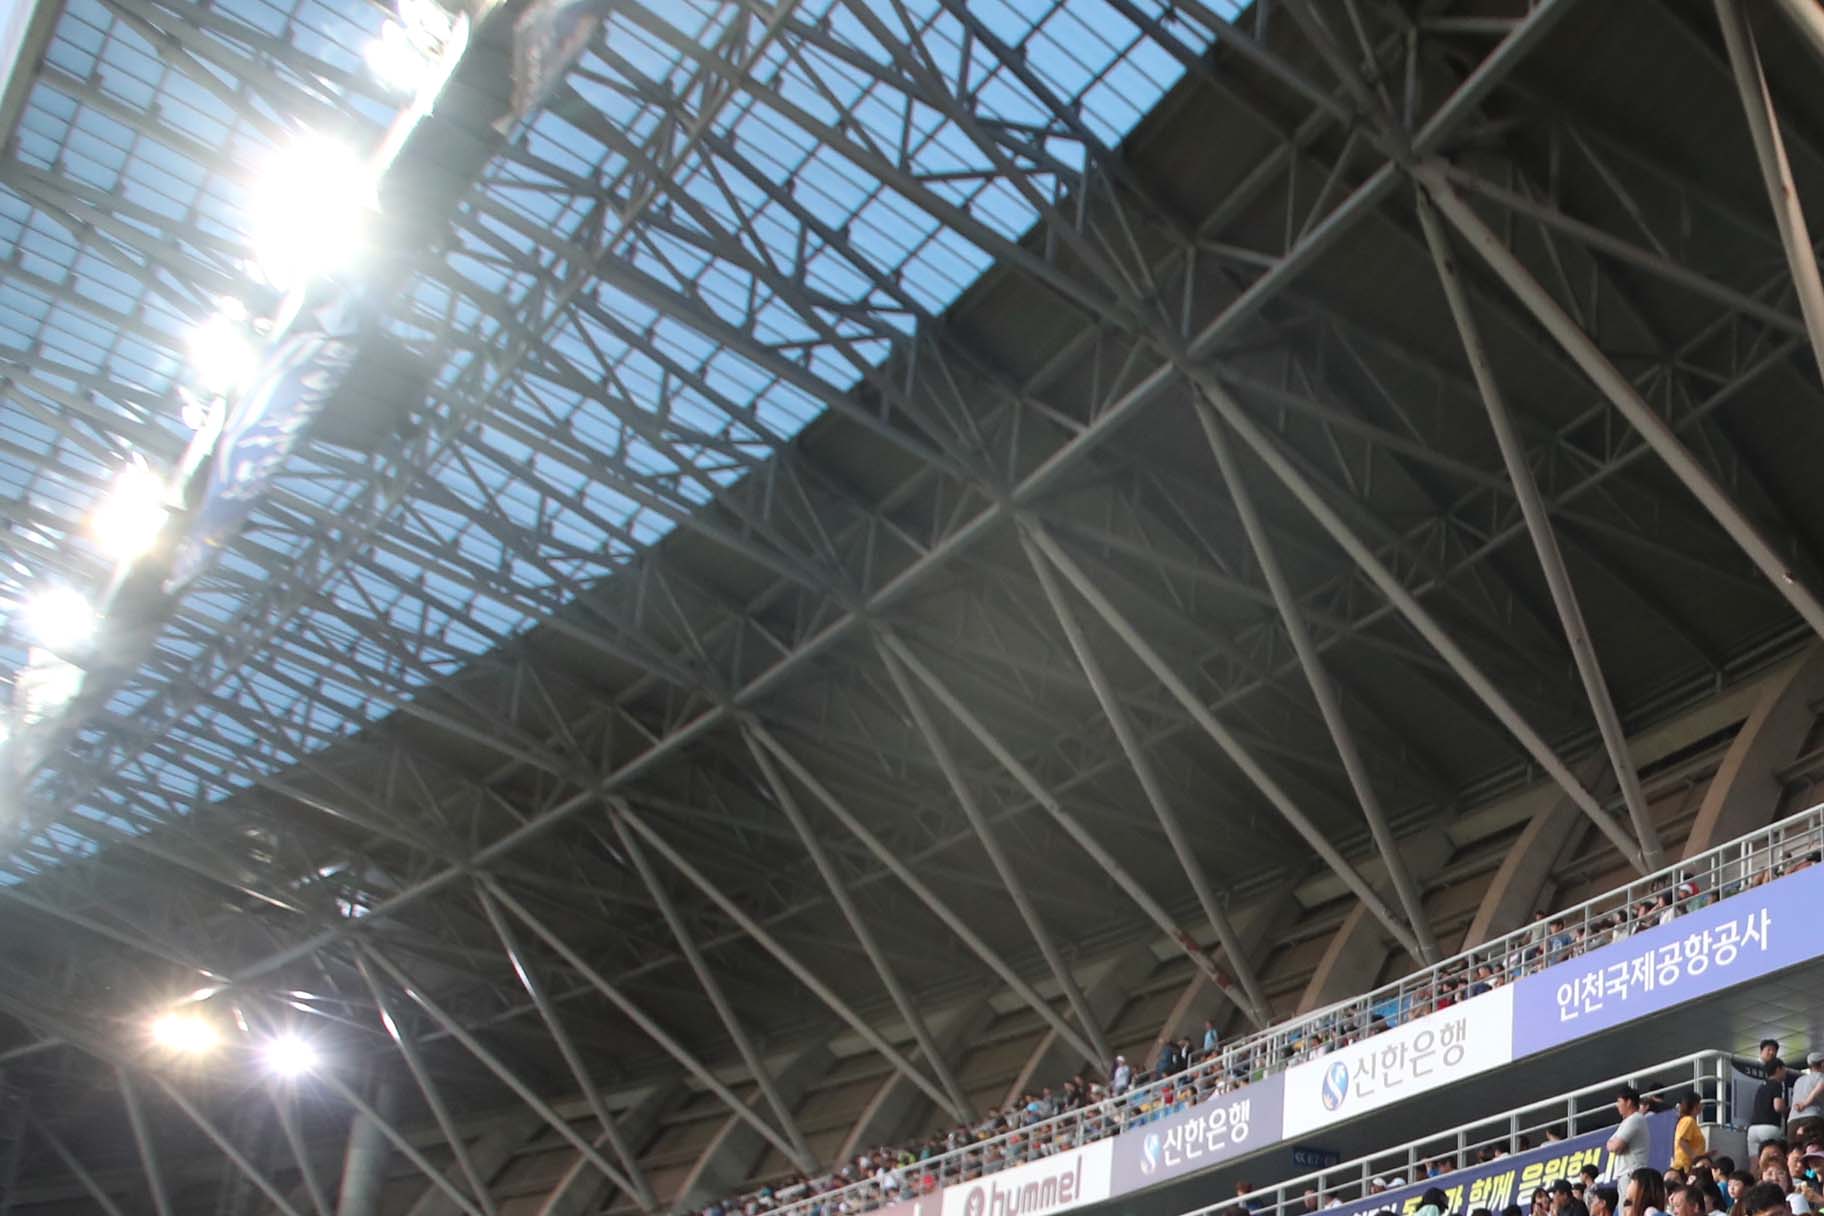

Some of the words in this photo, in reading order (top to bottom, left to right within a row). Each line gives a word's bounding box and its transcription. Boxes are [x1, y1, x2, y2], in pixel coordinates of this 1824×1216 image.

[1556, 907, 1772, 1022] 인천국제공항공사
[1353, 1017, 1468, 1099] 신한은행
[1162, 1098, 1251, 1167] 신한은행
